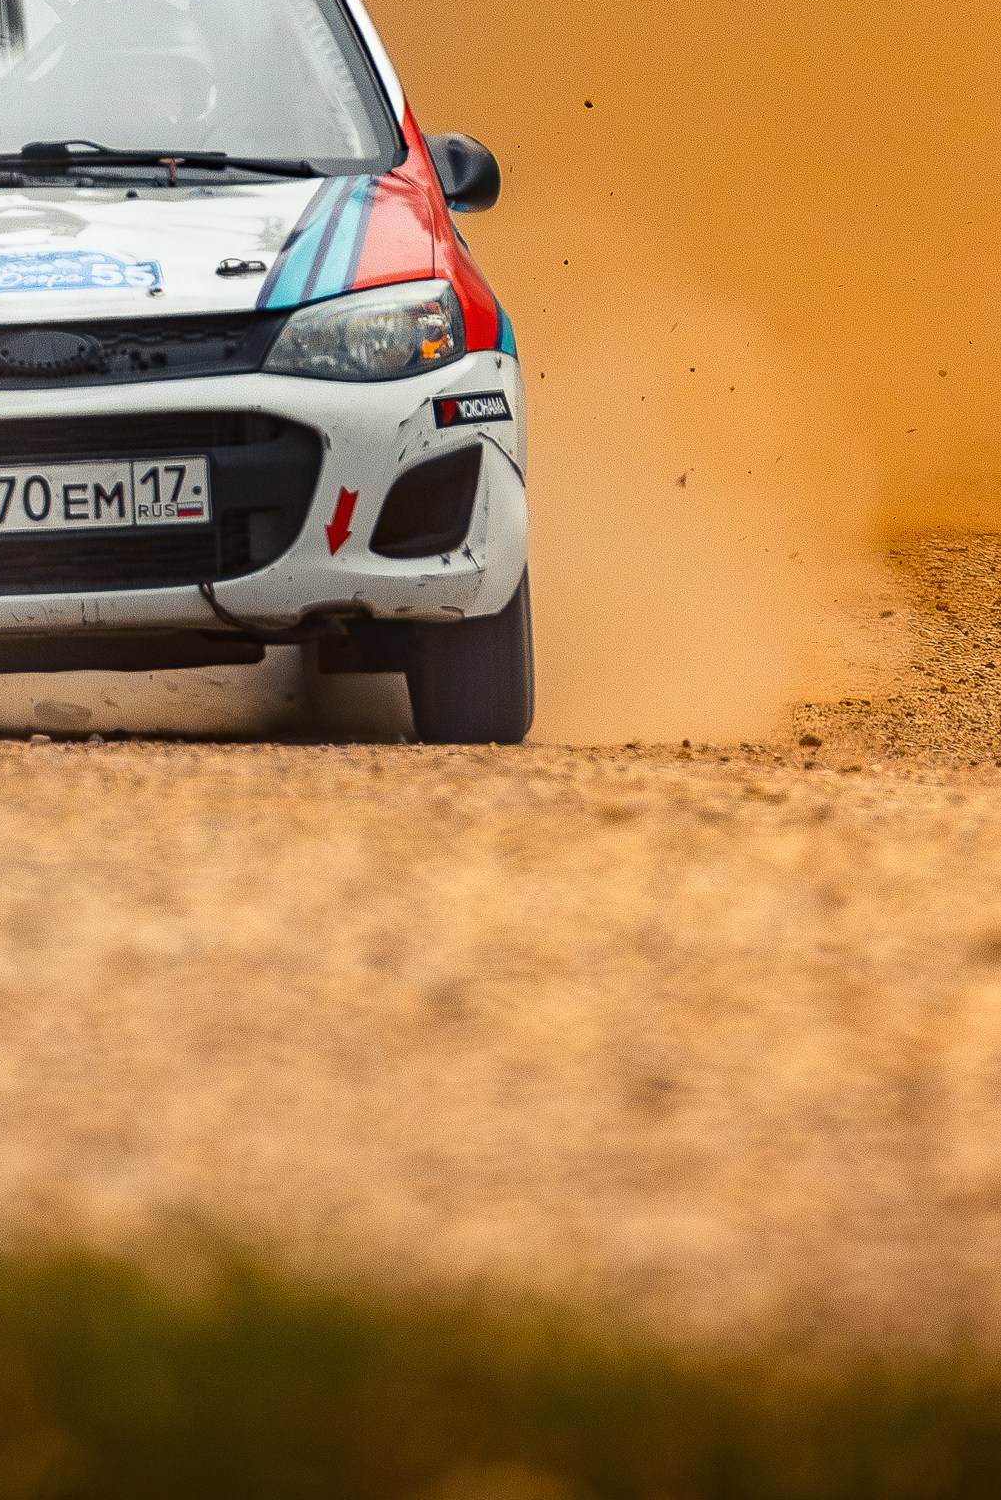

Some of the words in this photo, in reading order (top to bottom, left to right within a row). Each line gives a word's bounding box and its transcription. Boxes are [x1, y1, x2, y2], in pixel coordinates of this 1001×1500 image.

[91, 263, 155, 287] 55
[456, 397, 507, 418] YOKOHAMA
[139, 465, 188, 504] 17
[138, 503, 175, 518] RUS
